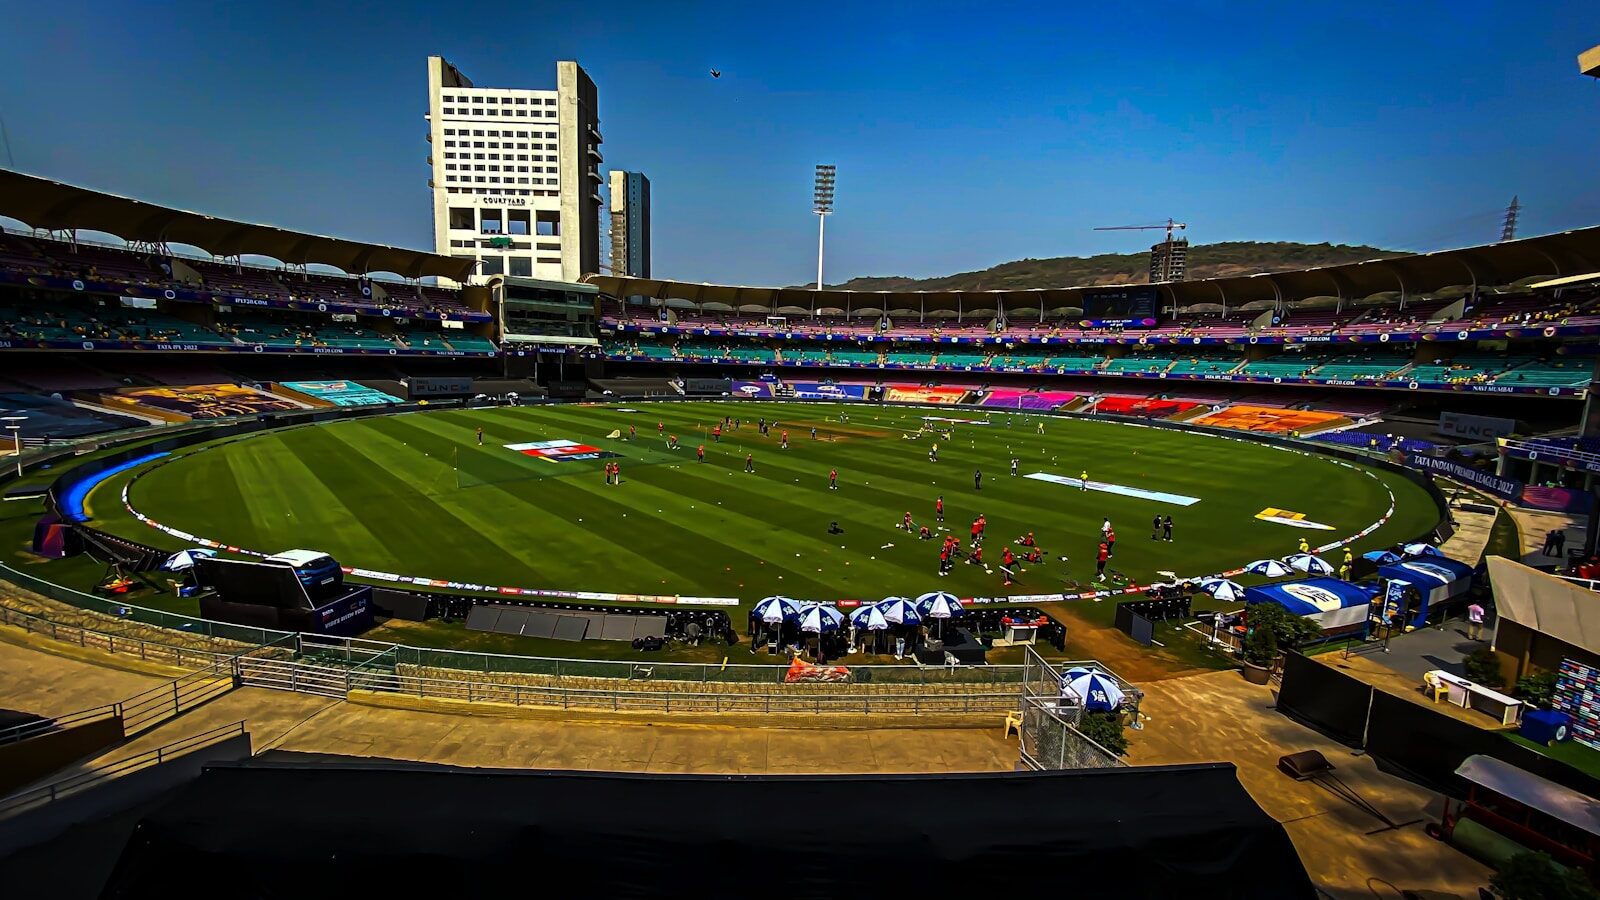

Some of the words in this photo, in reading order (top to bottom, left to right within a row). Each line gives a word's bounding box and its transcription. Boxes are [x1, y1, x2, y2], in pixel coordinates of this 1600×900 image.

[483, 197, 526, 205] COURTYARD
[1414, 455, 1431, 467] TATA
[1431, 459, 1454, 473] INDIAN
[1453, 465, 1476, 481] PREMIER
[1475, 473, 1498, 489] LEAGUE
[1497, 479, 1514, 495] 2022
